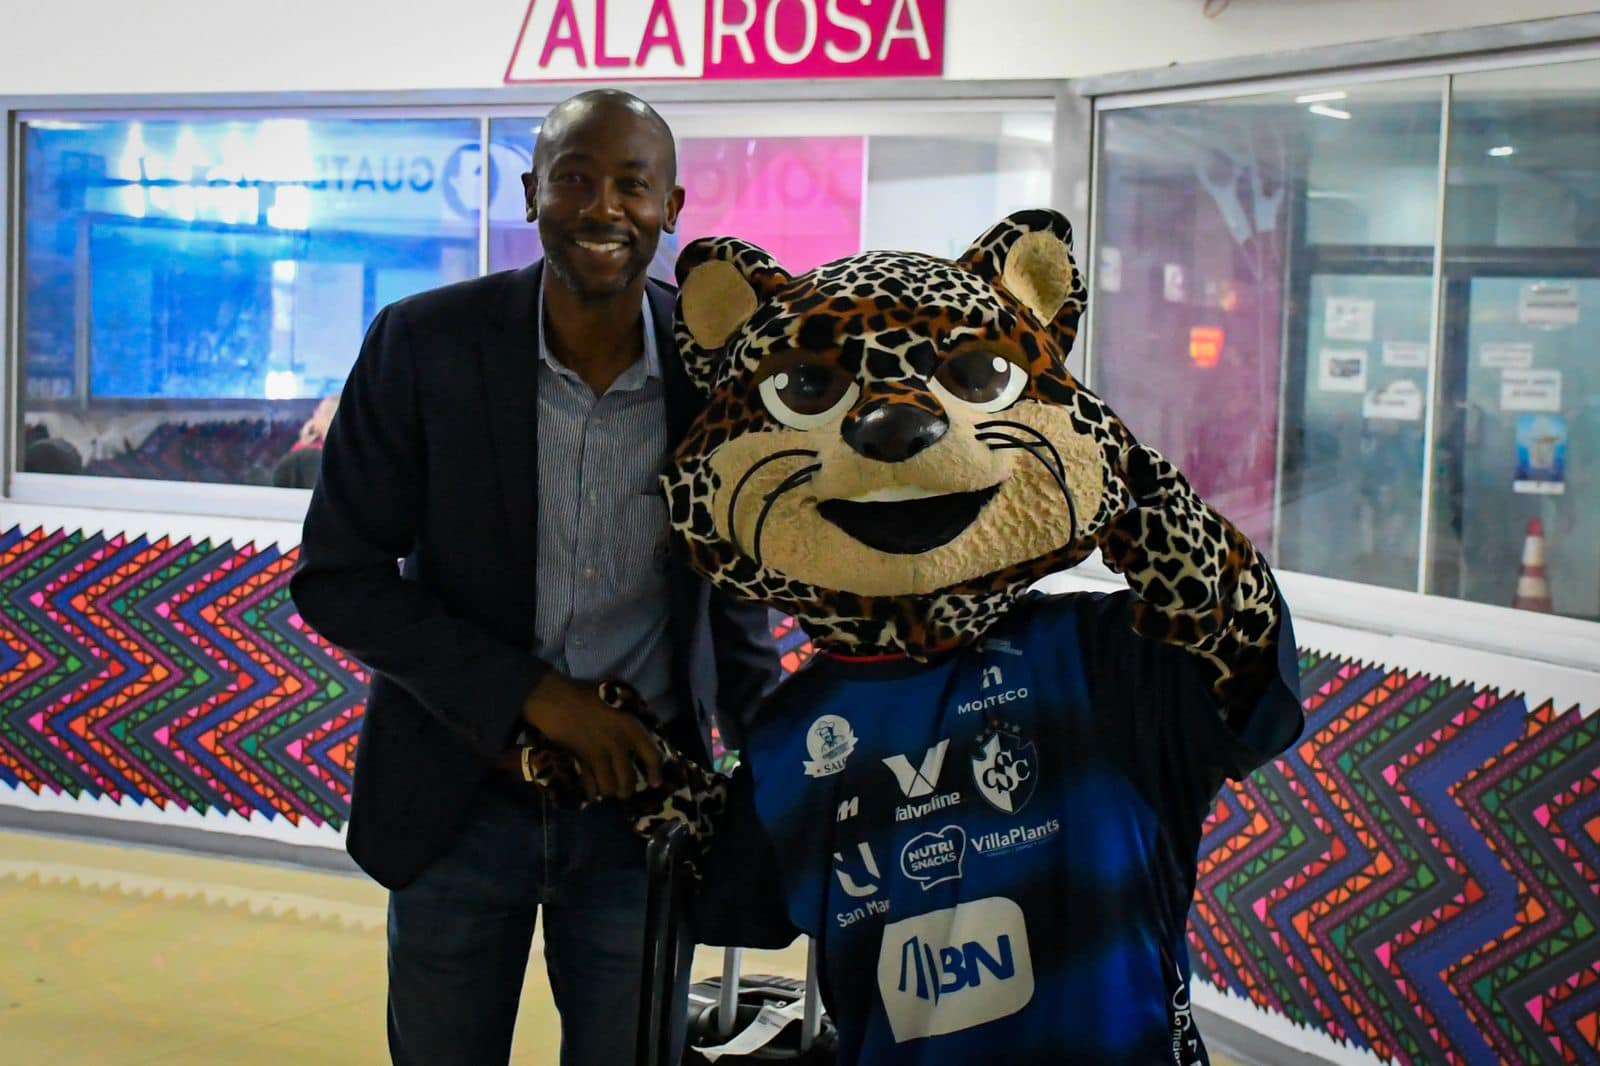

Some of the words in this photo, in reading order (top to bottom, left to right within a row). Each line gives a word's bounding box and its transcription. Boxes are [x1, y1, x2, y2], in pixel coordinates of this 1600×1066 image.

[537, 0, 686, 69] ALA
[711, 0, 932, 66] ROSA
[957, 687, 1029, 715] MOITECO
[970, 818, 1060, 853] VillaPlants
[907, 839, 955, 863] NUTRI
[911, 852, 957, 873] SNACKS
[836, 906, 866, 928] San
